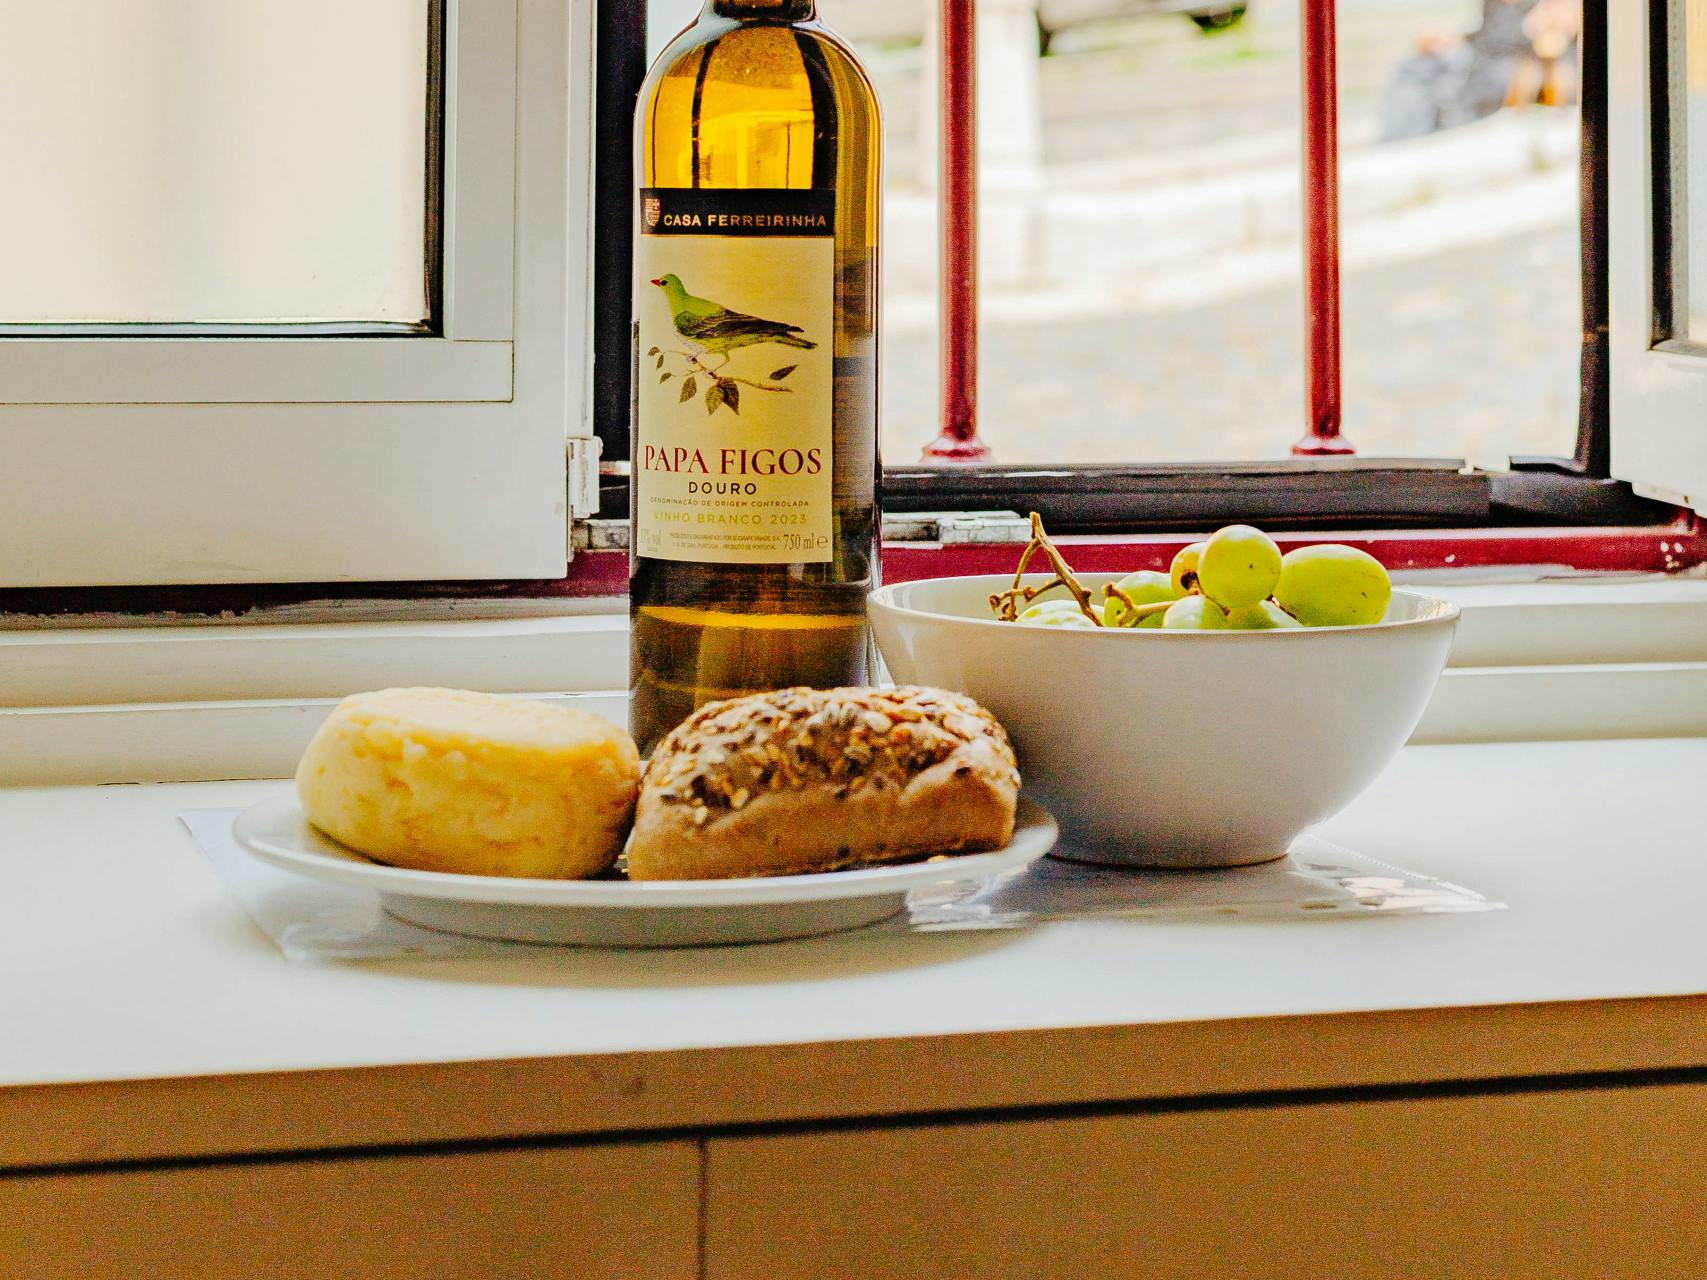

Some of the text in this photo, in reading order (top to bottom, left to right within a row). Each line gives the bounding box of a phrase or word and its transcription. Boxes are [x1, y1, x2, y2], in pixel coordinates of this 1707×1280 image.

[664, 214, 827, 227] CASA FERREIRINHA
[644, 445, 822, 475] PAPA FIGOS
[689, 481, 757, 495] DOURO
[751, 500, 809, 508] CONTROLADA
[653, 512, 807, 525] VINHO BRANCO 2023
[783, 534, 801, 550] 750
[803, 532, 814, 550] ml
